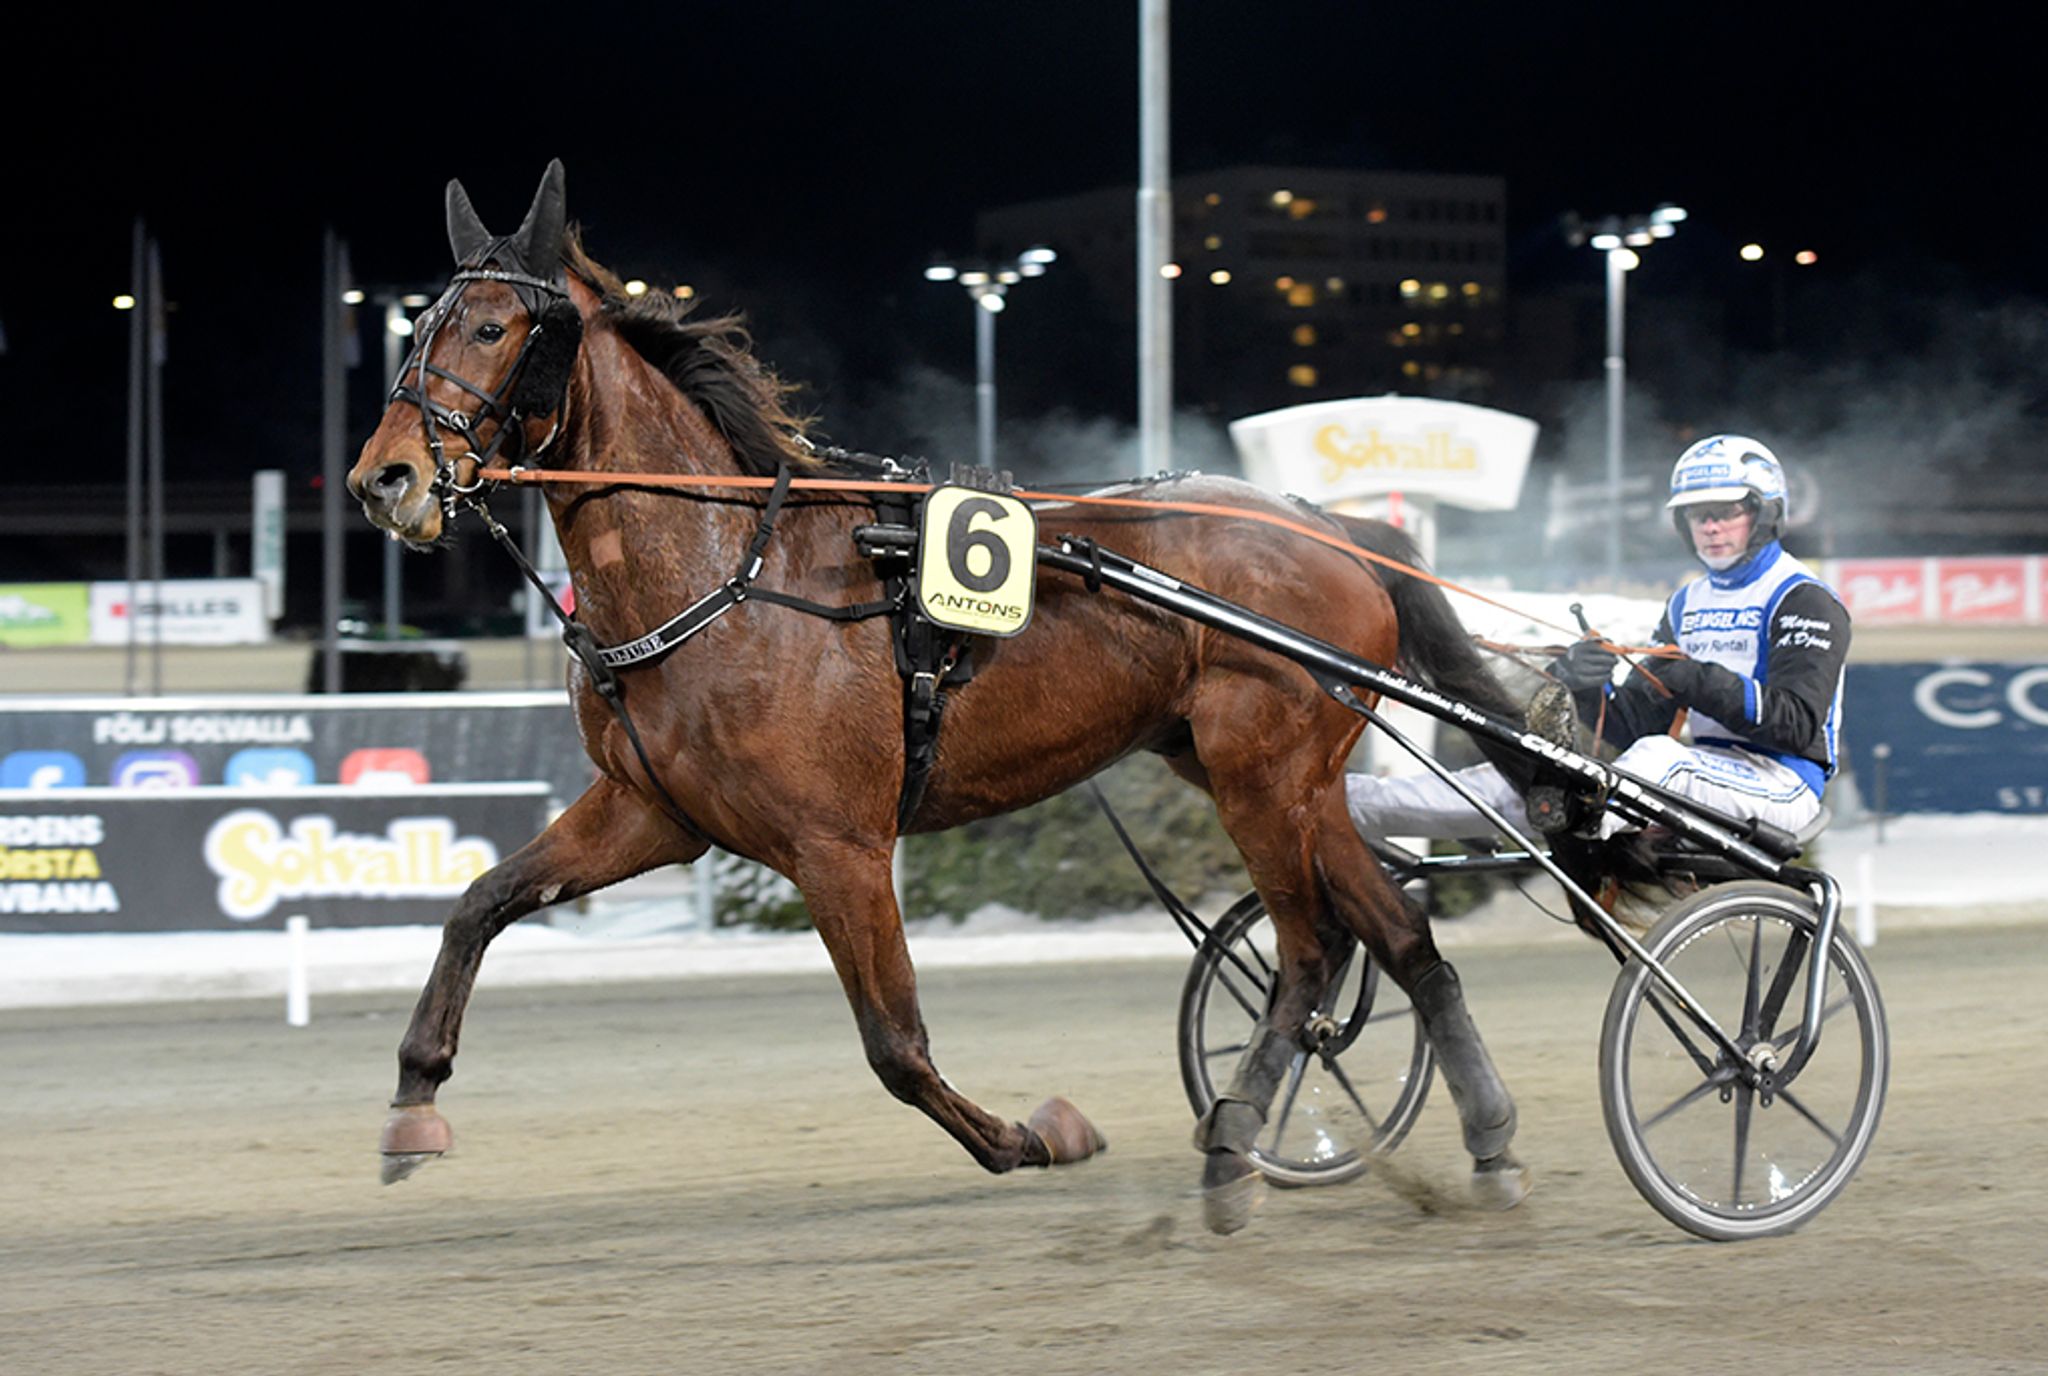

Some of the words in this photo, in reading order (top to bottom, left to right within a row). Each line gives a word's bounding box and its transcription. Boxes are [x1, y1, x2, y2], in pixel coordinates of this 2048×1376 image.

[1312, 423, 1477, 484] Solvalla
[946, 496, 1011, 593] 6
[928, 592, 1022, 619] ANTONS
[94, 712, 166, 744] FÖLJ
[170, 716, 312, 743] SOLVALLA
[208, 812, 496, 917] Solvalla
